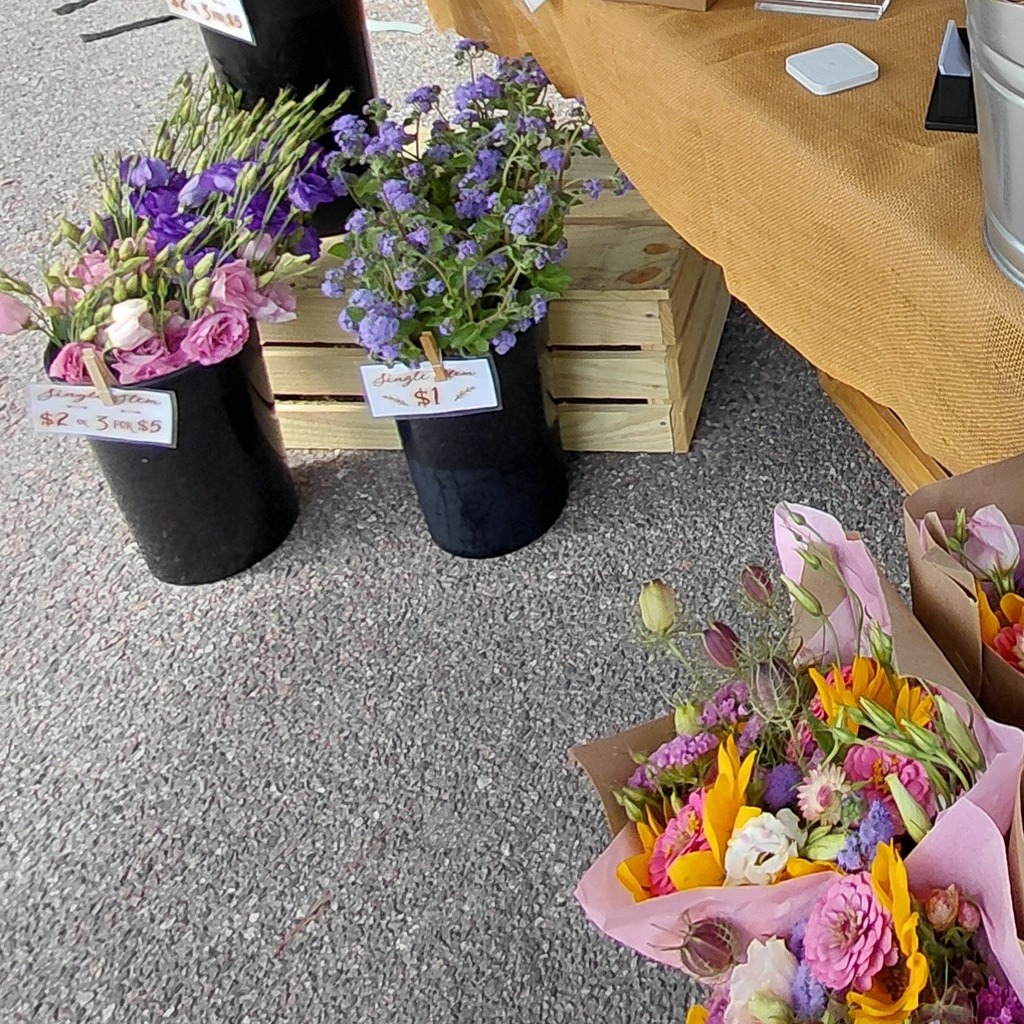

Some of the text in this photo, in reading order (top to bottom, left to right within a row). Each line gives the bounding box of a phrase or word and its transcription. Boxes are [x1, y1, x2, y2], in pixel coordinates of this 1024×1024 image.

[444, 367, 477, 381] tem
[37, 388, 101, 404] Singl
[414, 387, 440, 408] $1
[39, 410, 70, 427] $2
[96, 415, 110, 431] 3
[138, 419, 162, 433] $5
